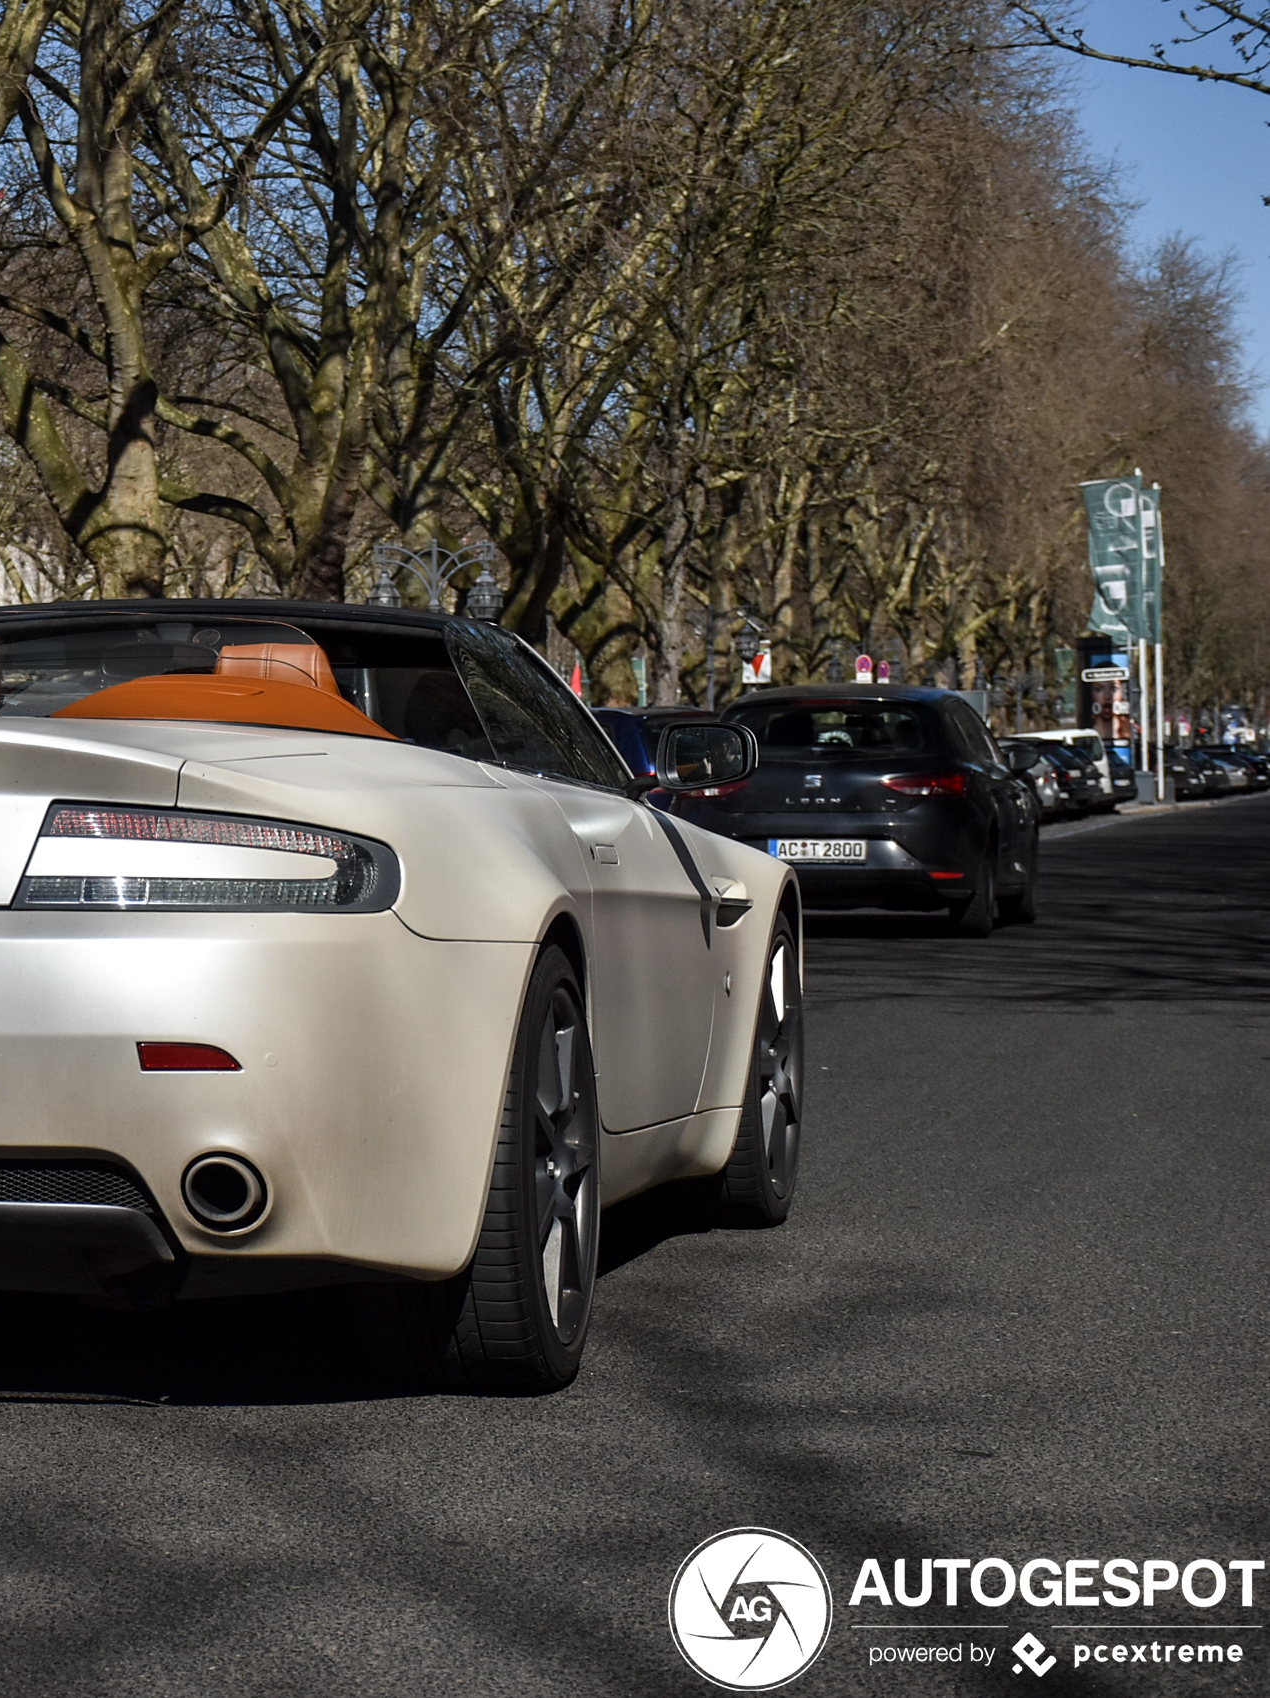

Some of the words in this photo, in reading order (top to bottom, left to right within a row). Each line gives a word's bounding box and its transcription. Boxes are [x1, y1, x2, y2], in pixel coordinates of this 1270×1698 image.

[778, 842, 798, 857] AC
[809, 842, 820, 857] T
[823, 842, 863, 858] 2800
